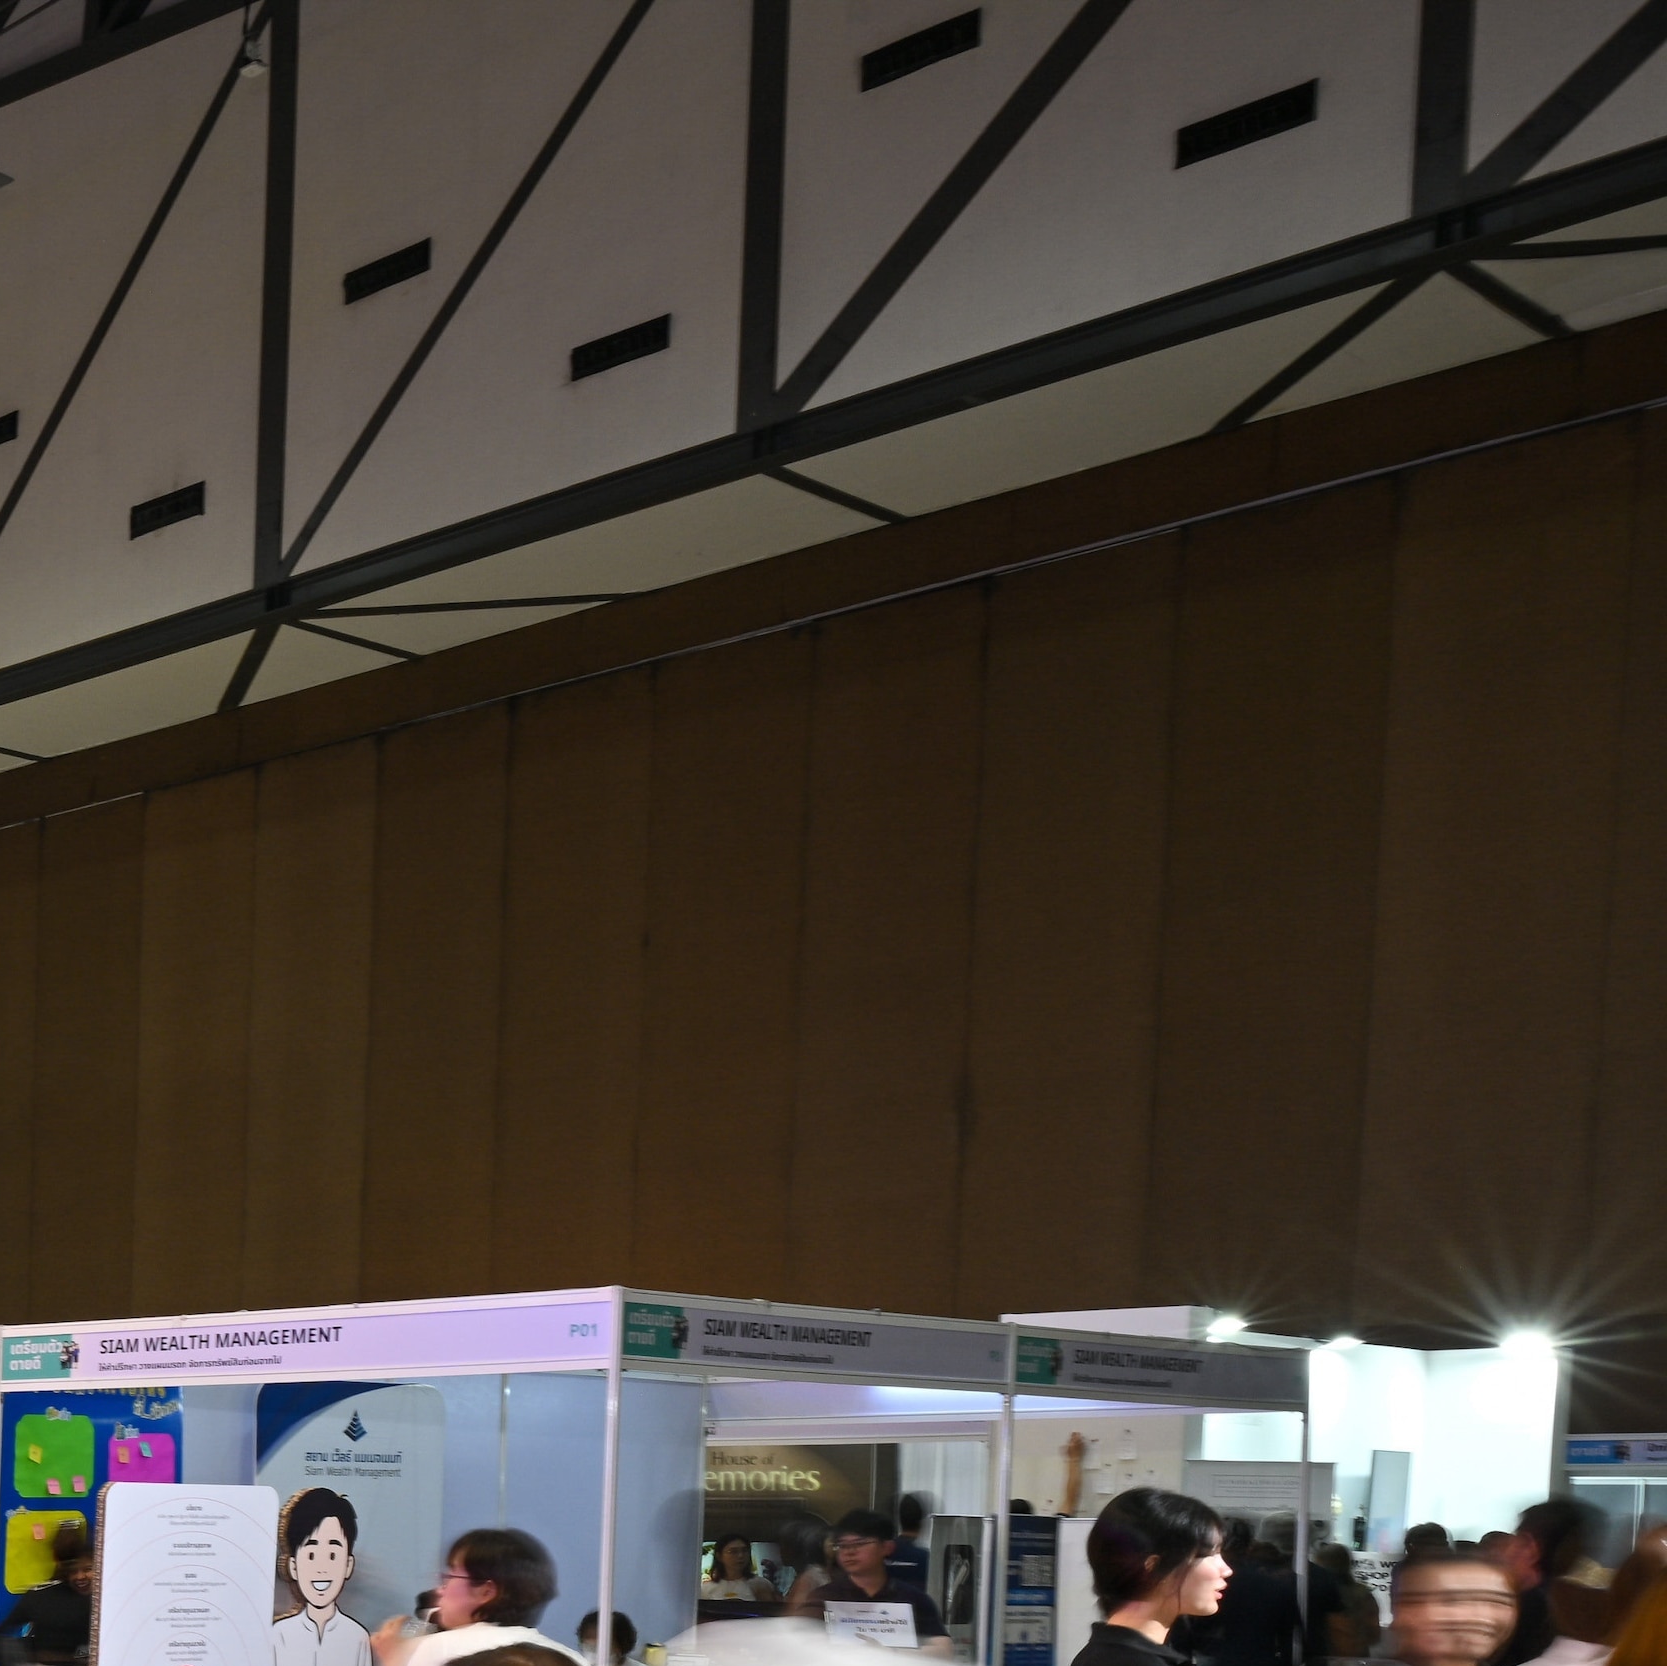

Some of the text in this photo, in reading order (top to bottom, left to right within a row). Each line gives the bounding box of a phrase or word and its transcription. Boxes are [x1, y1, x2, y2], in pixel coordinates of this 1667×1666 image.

[99, 1326, 342, 1355] SIAM WEALTH MANAGEMENT
[570, 1322, 599, 1338] P01
[703, 1318, 873, 1348] SIAM WEALTH MANAGEMENT
[711, 1451, 776, 1466] House of
[305, 1465, 324, 1476] Siam
[704, 1465, 822, 1492] emories
